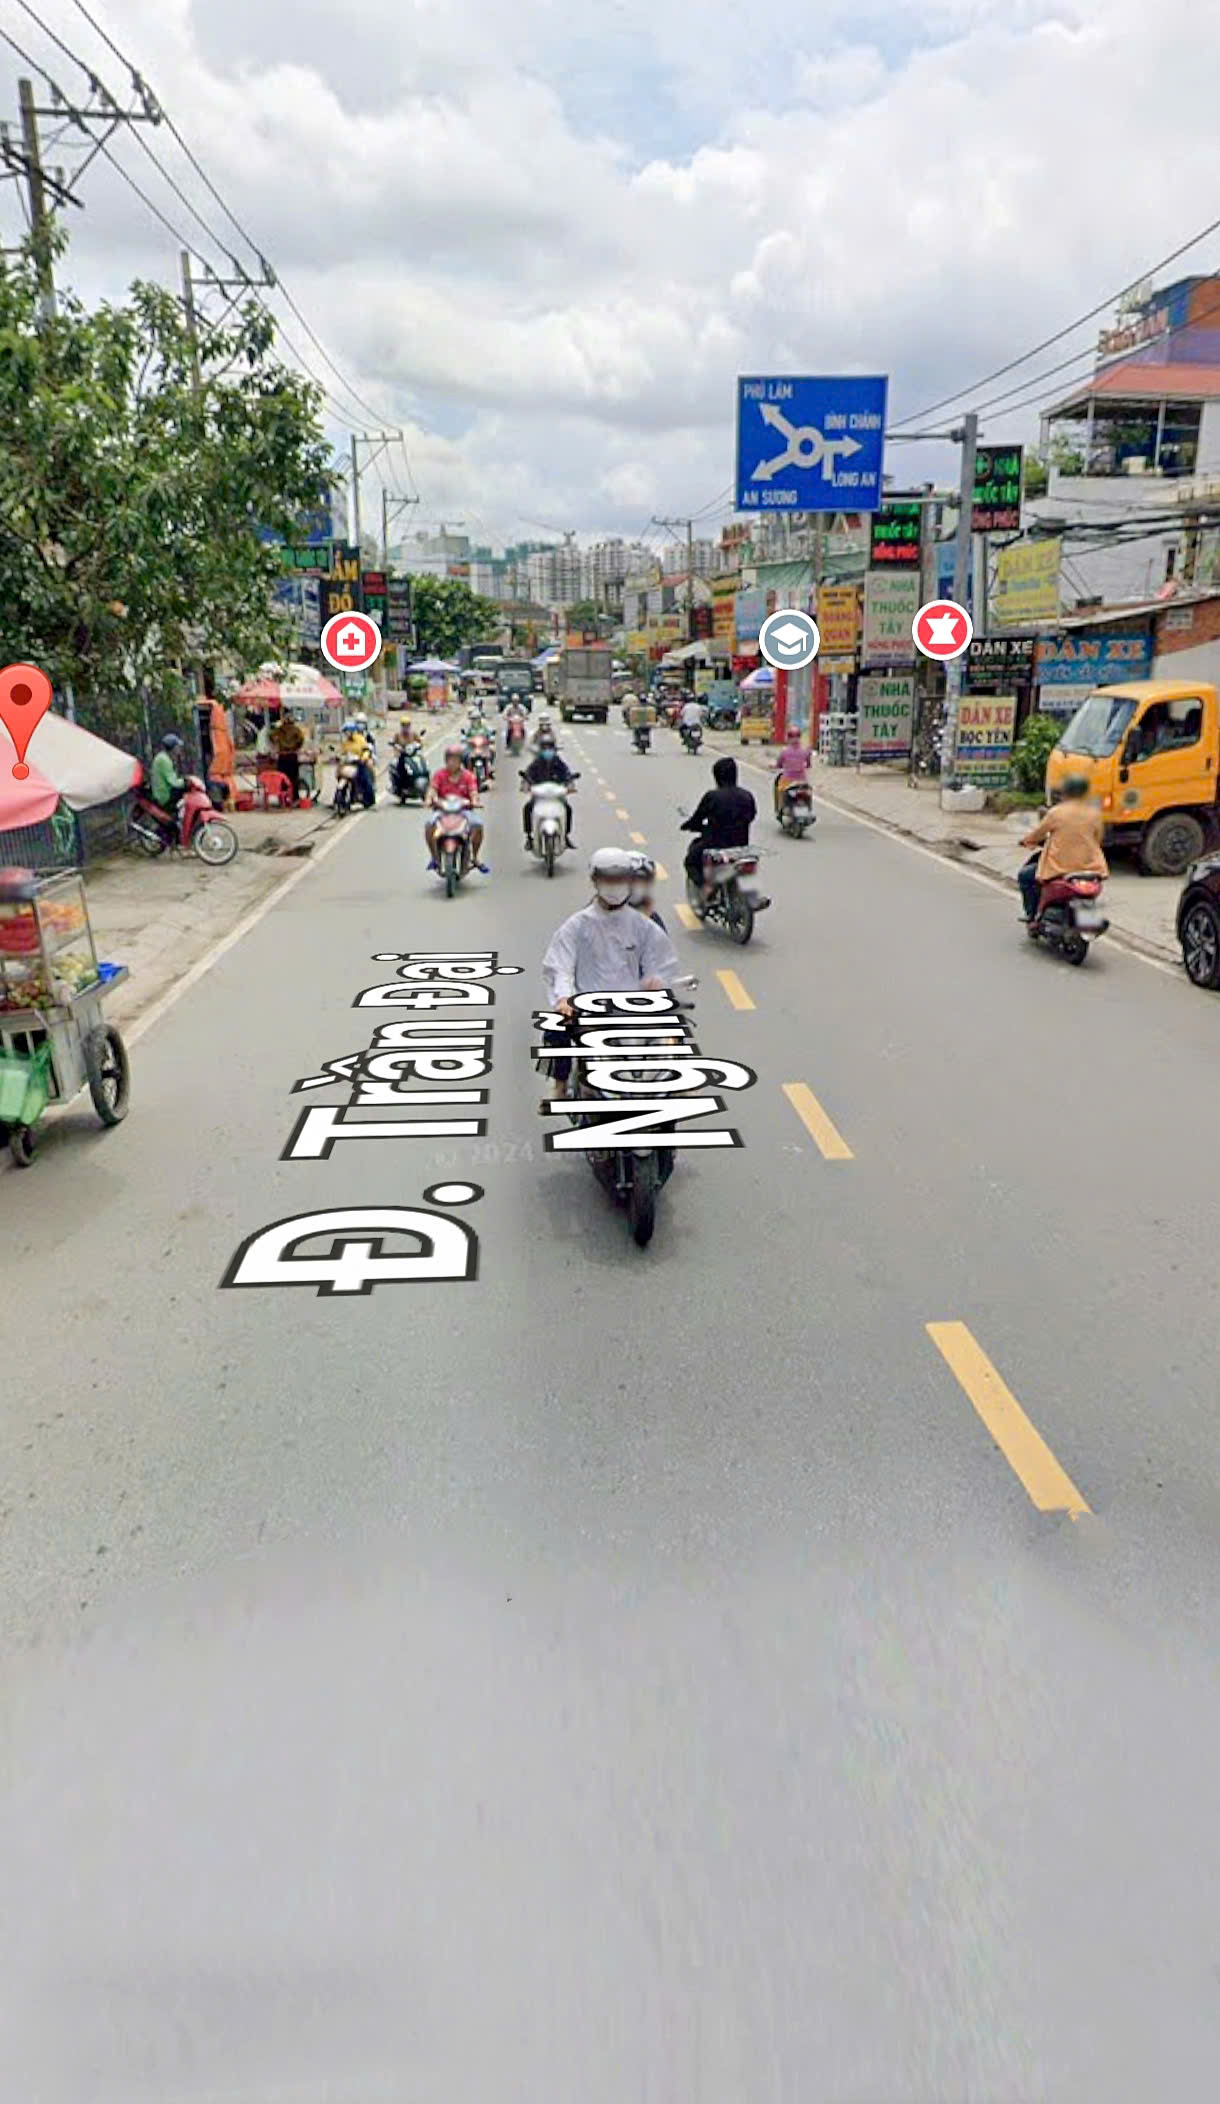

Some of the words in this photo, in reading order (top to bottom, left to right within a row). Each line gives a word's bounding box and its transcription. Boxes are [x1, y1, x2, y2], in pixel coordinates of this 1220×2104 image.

[849, 409, 882, 430] CHÁNH
[832, 471, 859, 488] LONG
[859, 471, 877, 487] AN
[742, 490, 759, 505] AN
[871, 600, 914, 614] THUỐC
[878, 619, 903, 635] TÂY
[970, 638, 1007, 656] DÁN
[1009, 640, 1033, 655] XE
[1038, 638, 1100, 661] DÁN
[1106, 639, 1147, 660] XE
[879, 680, 910, 697] NHÀ
[863, 701, 910, 718] THUỐC
[960, 701, 991, 725] DÁN
[994, 706, 1012, 725] XE
[872, 722, 898, 738] TÂY
[960, 730, 983, 745] BỌC
[986, 727, 1010, 744] YÊN
